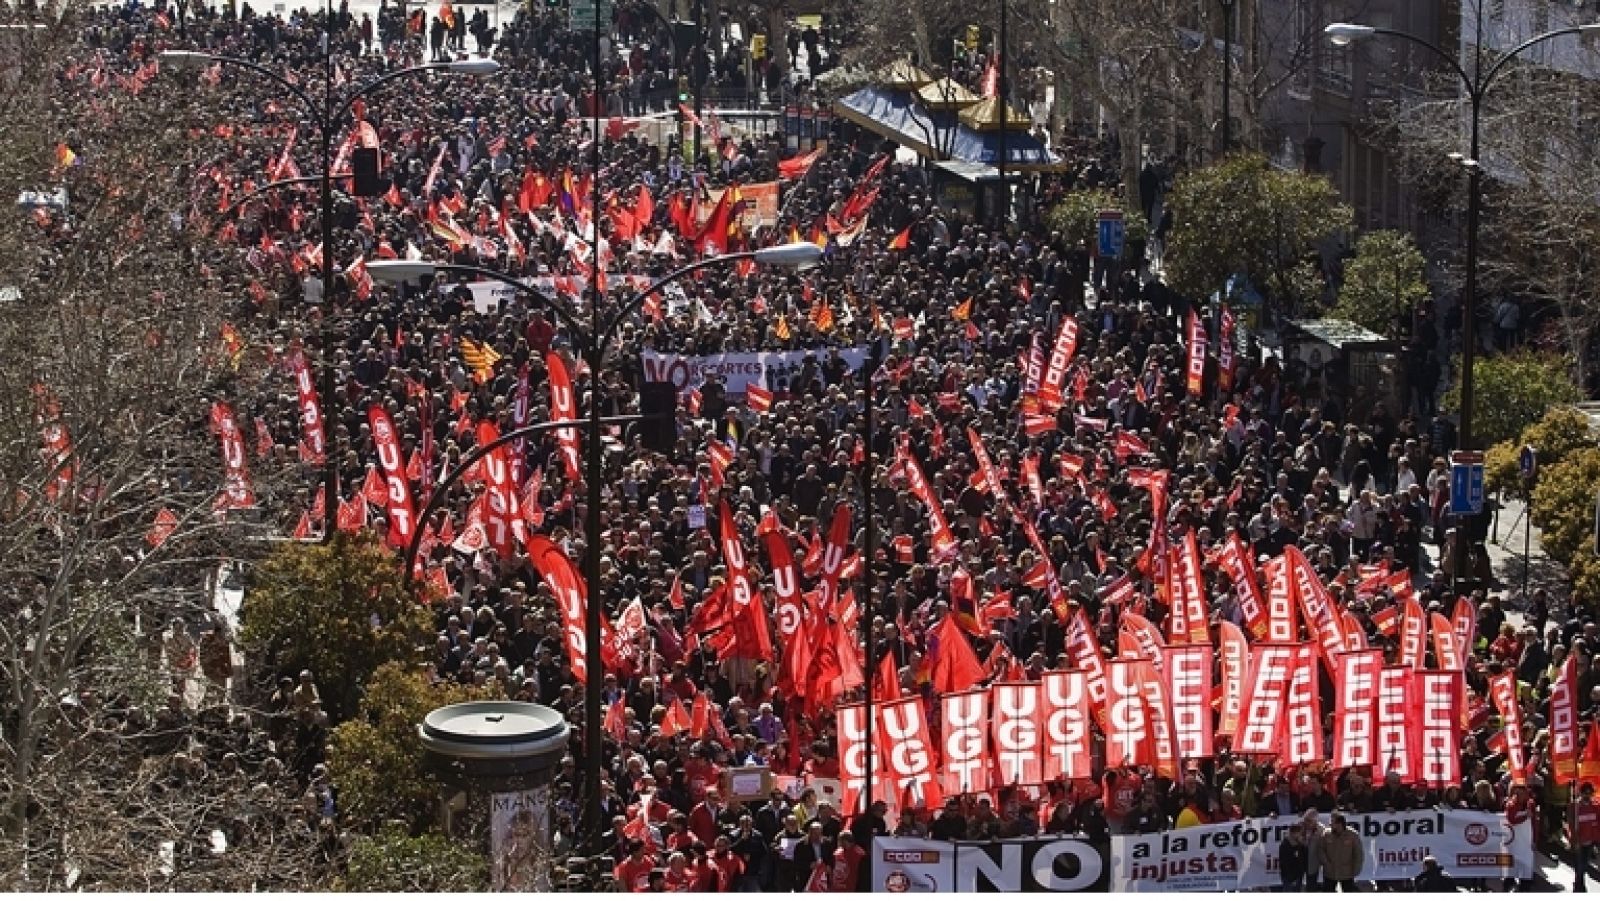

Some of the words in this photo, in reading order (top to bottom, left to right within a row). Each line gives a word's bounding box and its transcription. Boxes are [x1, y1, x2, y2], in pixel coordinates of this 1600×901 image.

[1046, 320, 1077, 384] CCOO
[948, 694, 982, 793] UGT
[1000, 686, 1036, 779] UGT
[1047, 673, 1084, 777] UGT
[1172, 653, 1202, 757] CCOO
[1242, 649, 1290, 750] CCOO
[1341, 655, 1374, 767] CCOO
[1379, 669, 1409, 775] CCOO
[1423, 675, 1452, 781] CCOO
[844, 704, 878, 812] UGT
[882, 702, 930, 804] UGT
[957, 840, 1102, 892] NO
[1131, 852, 1239, 883] injusta
[1379, 846, 1431, 864] inútil
[1132, 842, 1150, 859] a
[1162, 833, 1188, 855] la
[1460, 856, 1497, 865] CCOO
